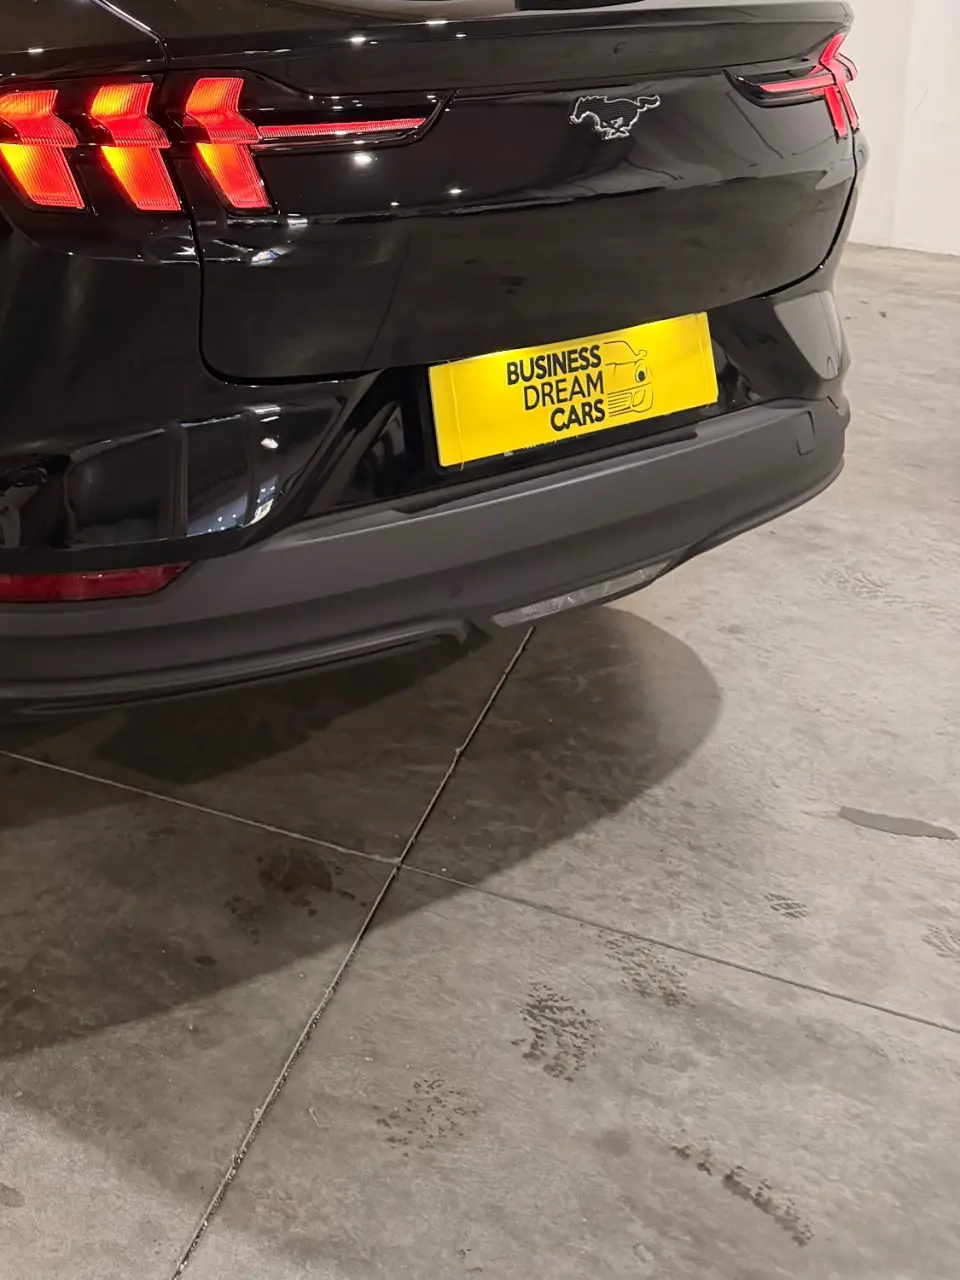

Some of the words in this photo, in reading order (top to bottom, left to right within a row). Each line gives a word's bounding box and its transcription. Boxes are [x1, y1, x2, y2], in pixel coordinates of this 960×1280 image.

[506, 344, 602, 386] BUSINESS
[523, 371, 605, 411] DREAM
[550, 399, 606, 432] CARS
